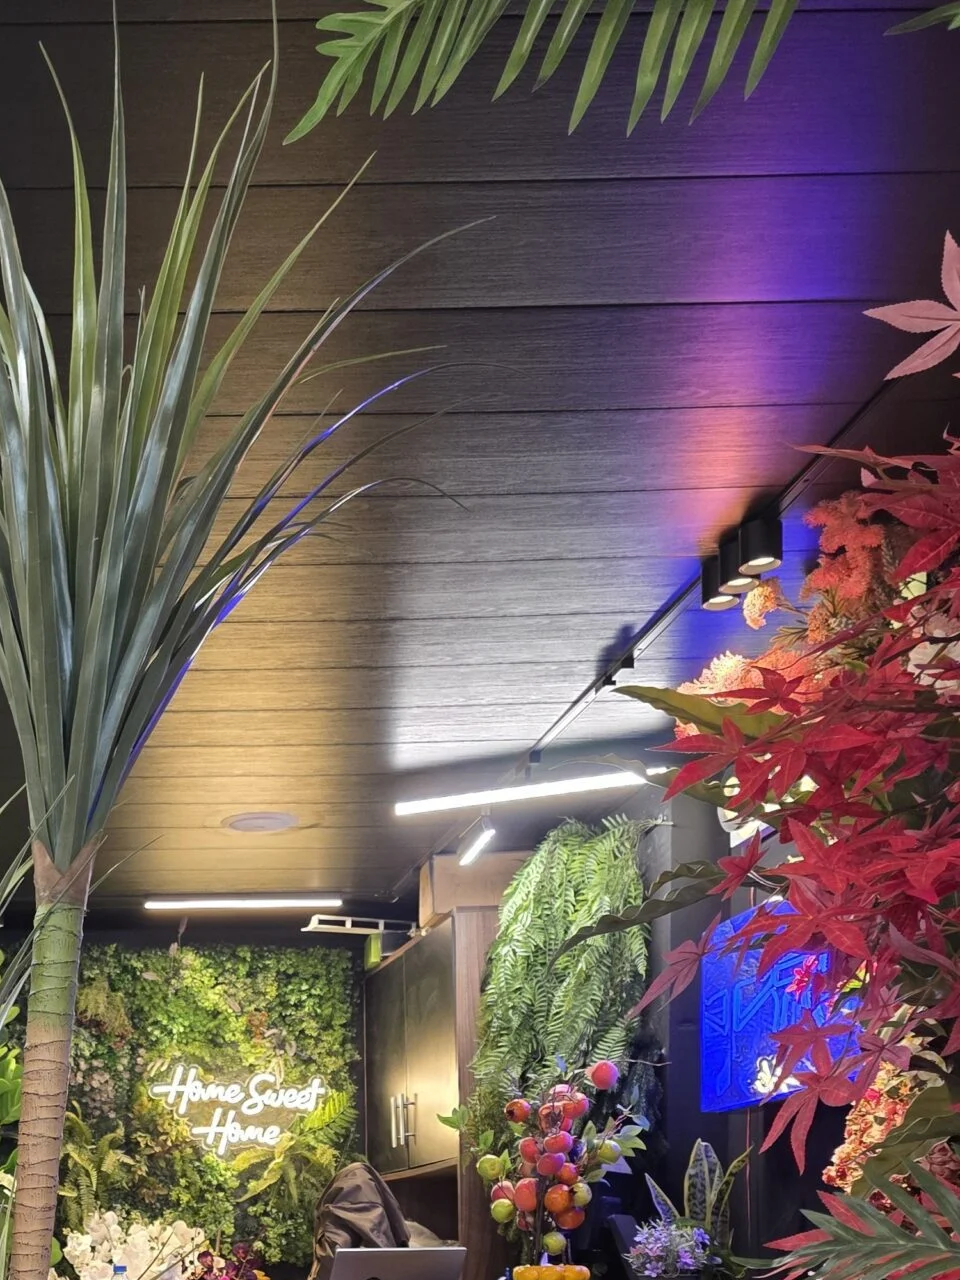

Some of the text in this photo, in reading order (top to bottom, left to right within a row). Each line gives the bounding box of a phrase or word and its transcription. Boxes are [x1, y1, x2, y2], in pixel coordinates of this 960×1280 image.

[151, 1064, 326, 1115] Home Sweet
[191, 1107, 281, 1155] Home
